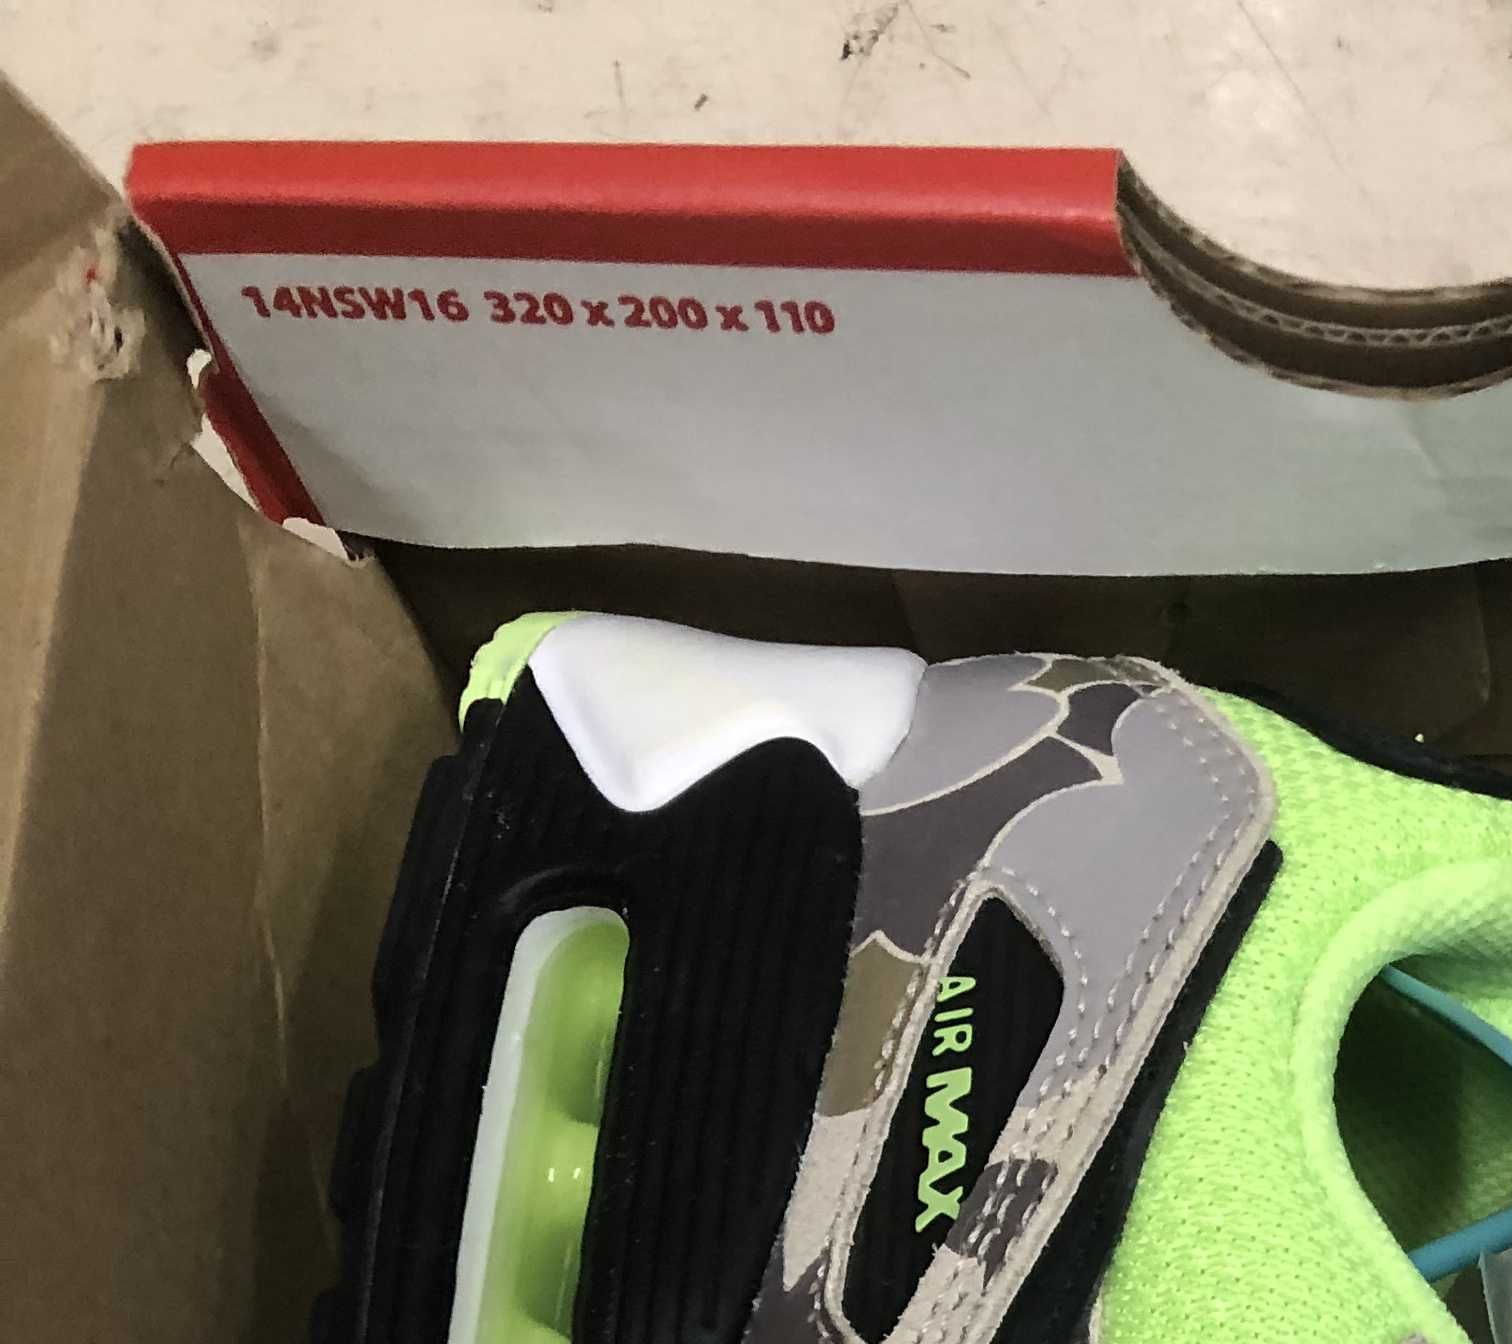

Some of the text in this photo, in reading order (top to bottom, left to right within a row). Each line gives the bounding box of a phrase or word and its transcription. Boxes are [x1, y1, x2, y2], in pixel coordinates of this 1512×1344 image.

[241, 286, 469, 322] 14NSW16
[914, 975, 977, 1233] AIR MAX
